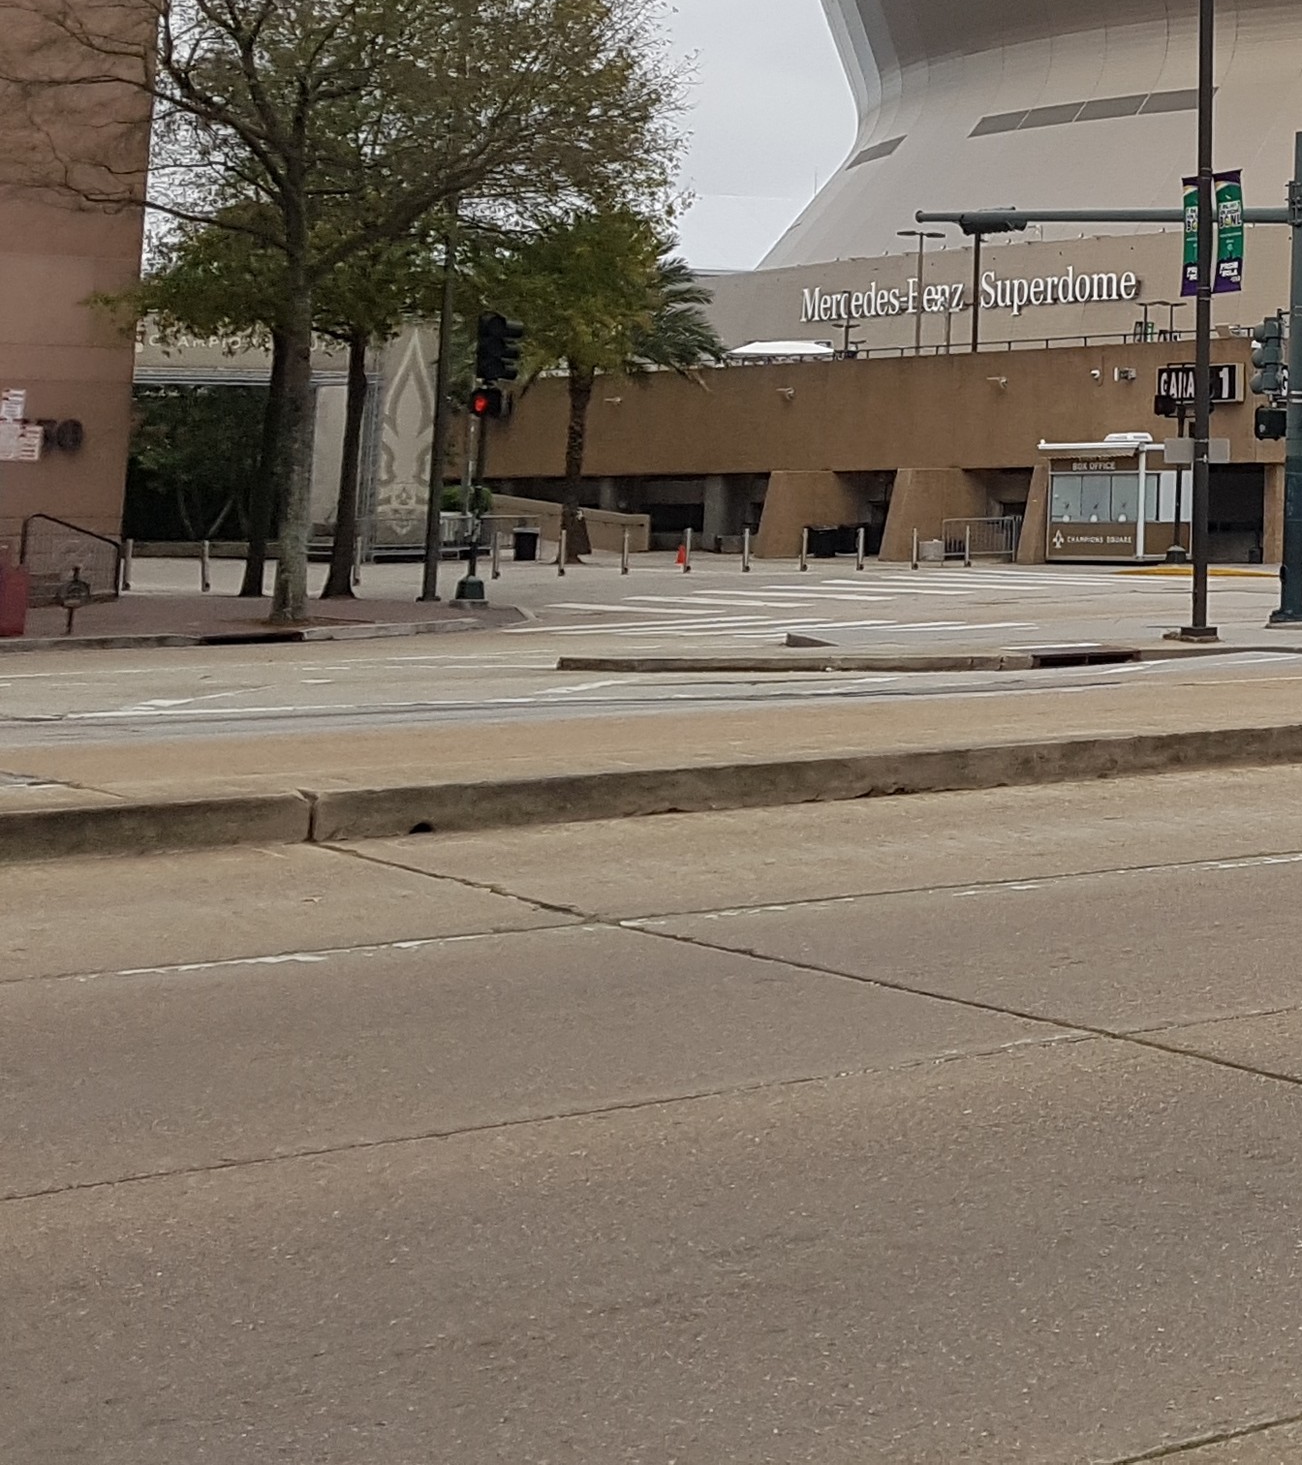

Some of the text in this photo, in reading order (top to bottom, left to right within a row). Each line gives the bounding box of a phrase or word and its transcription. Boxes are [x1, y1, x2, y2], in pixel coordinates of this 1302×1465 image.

[980, 266, 1136, 317] Superdome
[1160, 367, 1230, 399] GARA 1
[1072, 461, 1116, 470] BOX OFFICE
[1067, 536, 1133, 545] CHAMPIONS SQUARE
